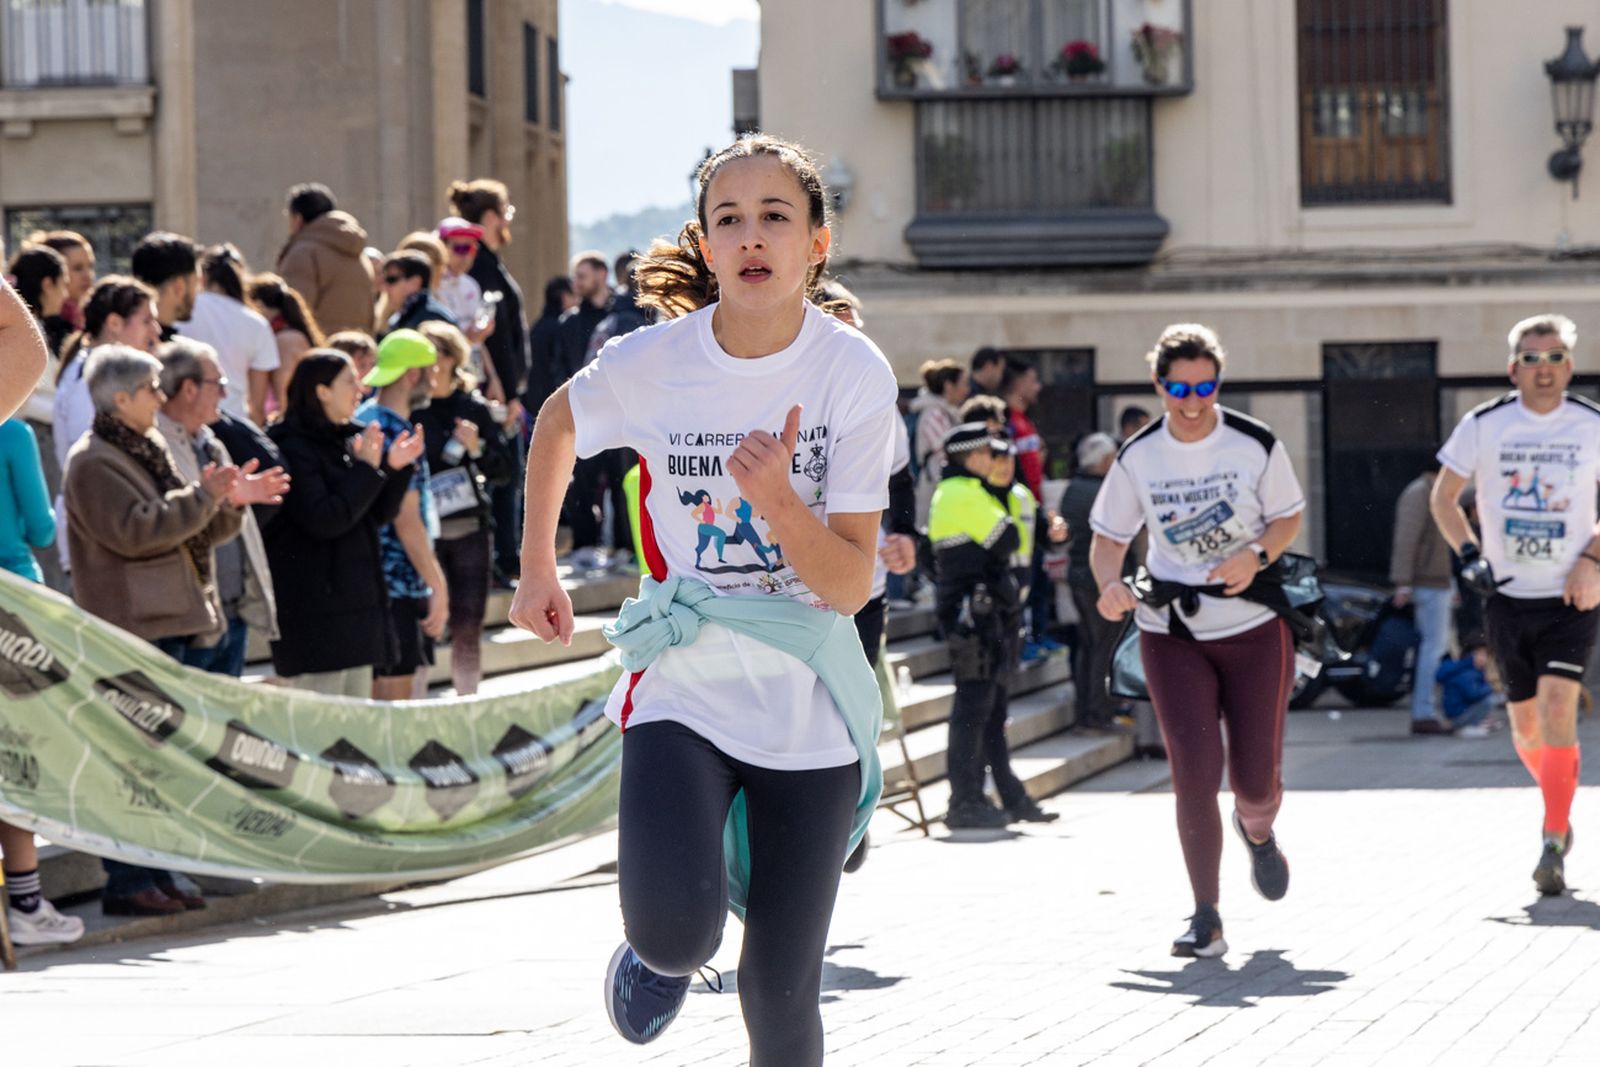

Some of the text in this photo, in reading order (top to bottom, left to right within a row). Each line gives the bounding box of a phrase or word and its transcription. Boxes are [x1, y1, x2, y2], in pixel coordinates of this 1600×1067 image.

[669, 432, 681, 446] VI
[684, 432, 746, 447] CARRER
[668, 453, 723, 477] BUENA
[1190, 527, 1231, 554] 283
[1515, 535, 1552, 558] 204
